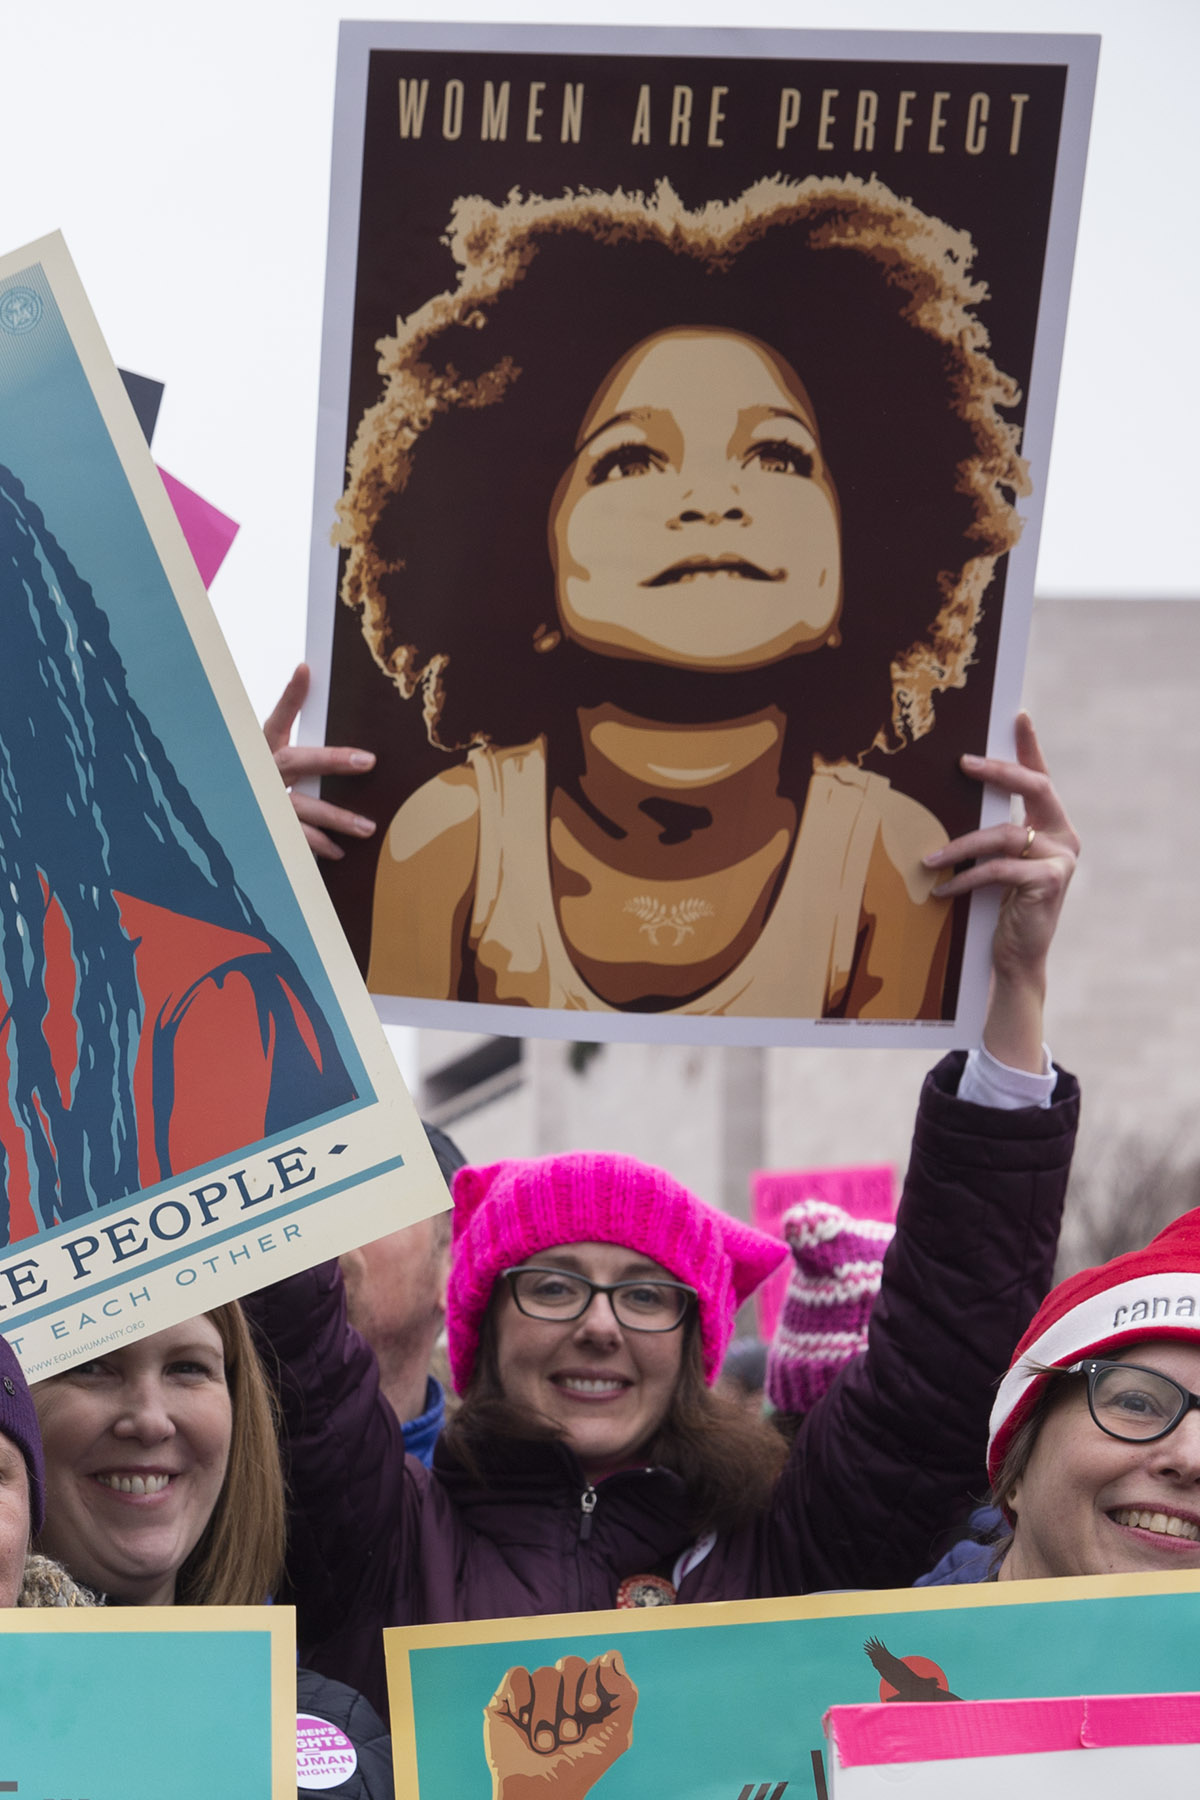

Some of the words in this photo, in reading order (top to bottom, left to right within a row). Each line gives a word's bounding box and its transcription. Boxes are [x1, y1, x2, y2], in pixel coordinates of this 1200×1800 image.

[399, 79, 584, 143] WOMEN
[632, 84, 728, 147] ARE
[777, 88, 1029, 155] PERFECT
[61, 1146, 316, 1280] PEOPLE
[50, 1287, 152, 1340] EACH
[175, 1223, 303, 1286] OTHER
[25, 1320, 145, 1375] WWW.EQUALHUMANITY.ORG
[297, 1767, 347, 1776] RIGHTS
